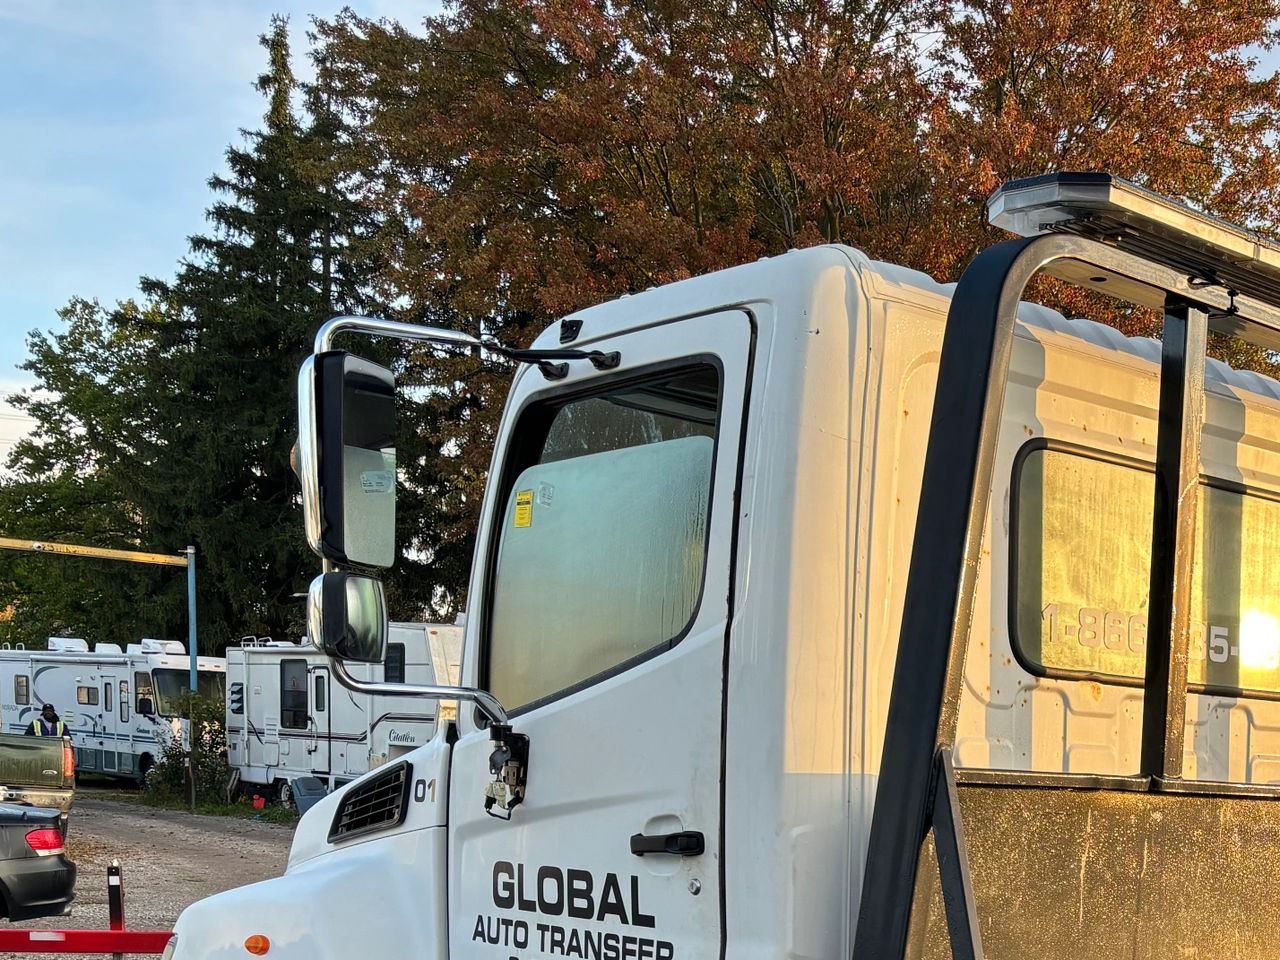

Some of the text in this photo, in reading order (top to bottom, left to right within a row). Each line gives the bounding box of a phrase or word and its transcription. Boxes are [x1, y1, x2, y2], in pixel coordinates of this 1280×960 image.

[388, 728, 416, 743] Citation
[414, 778, 437, 803] 01
[492, 860, 656, 929] GLOBAL
[471, 914, 530, 950] AUTO
